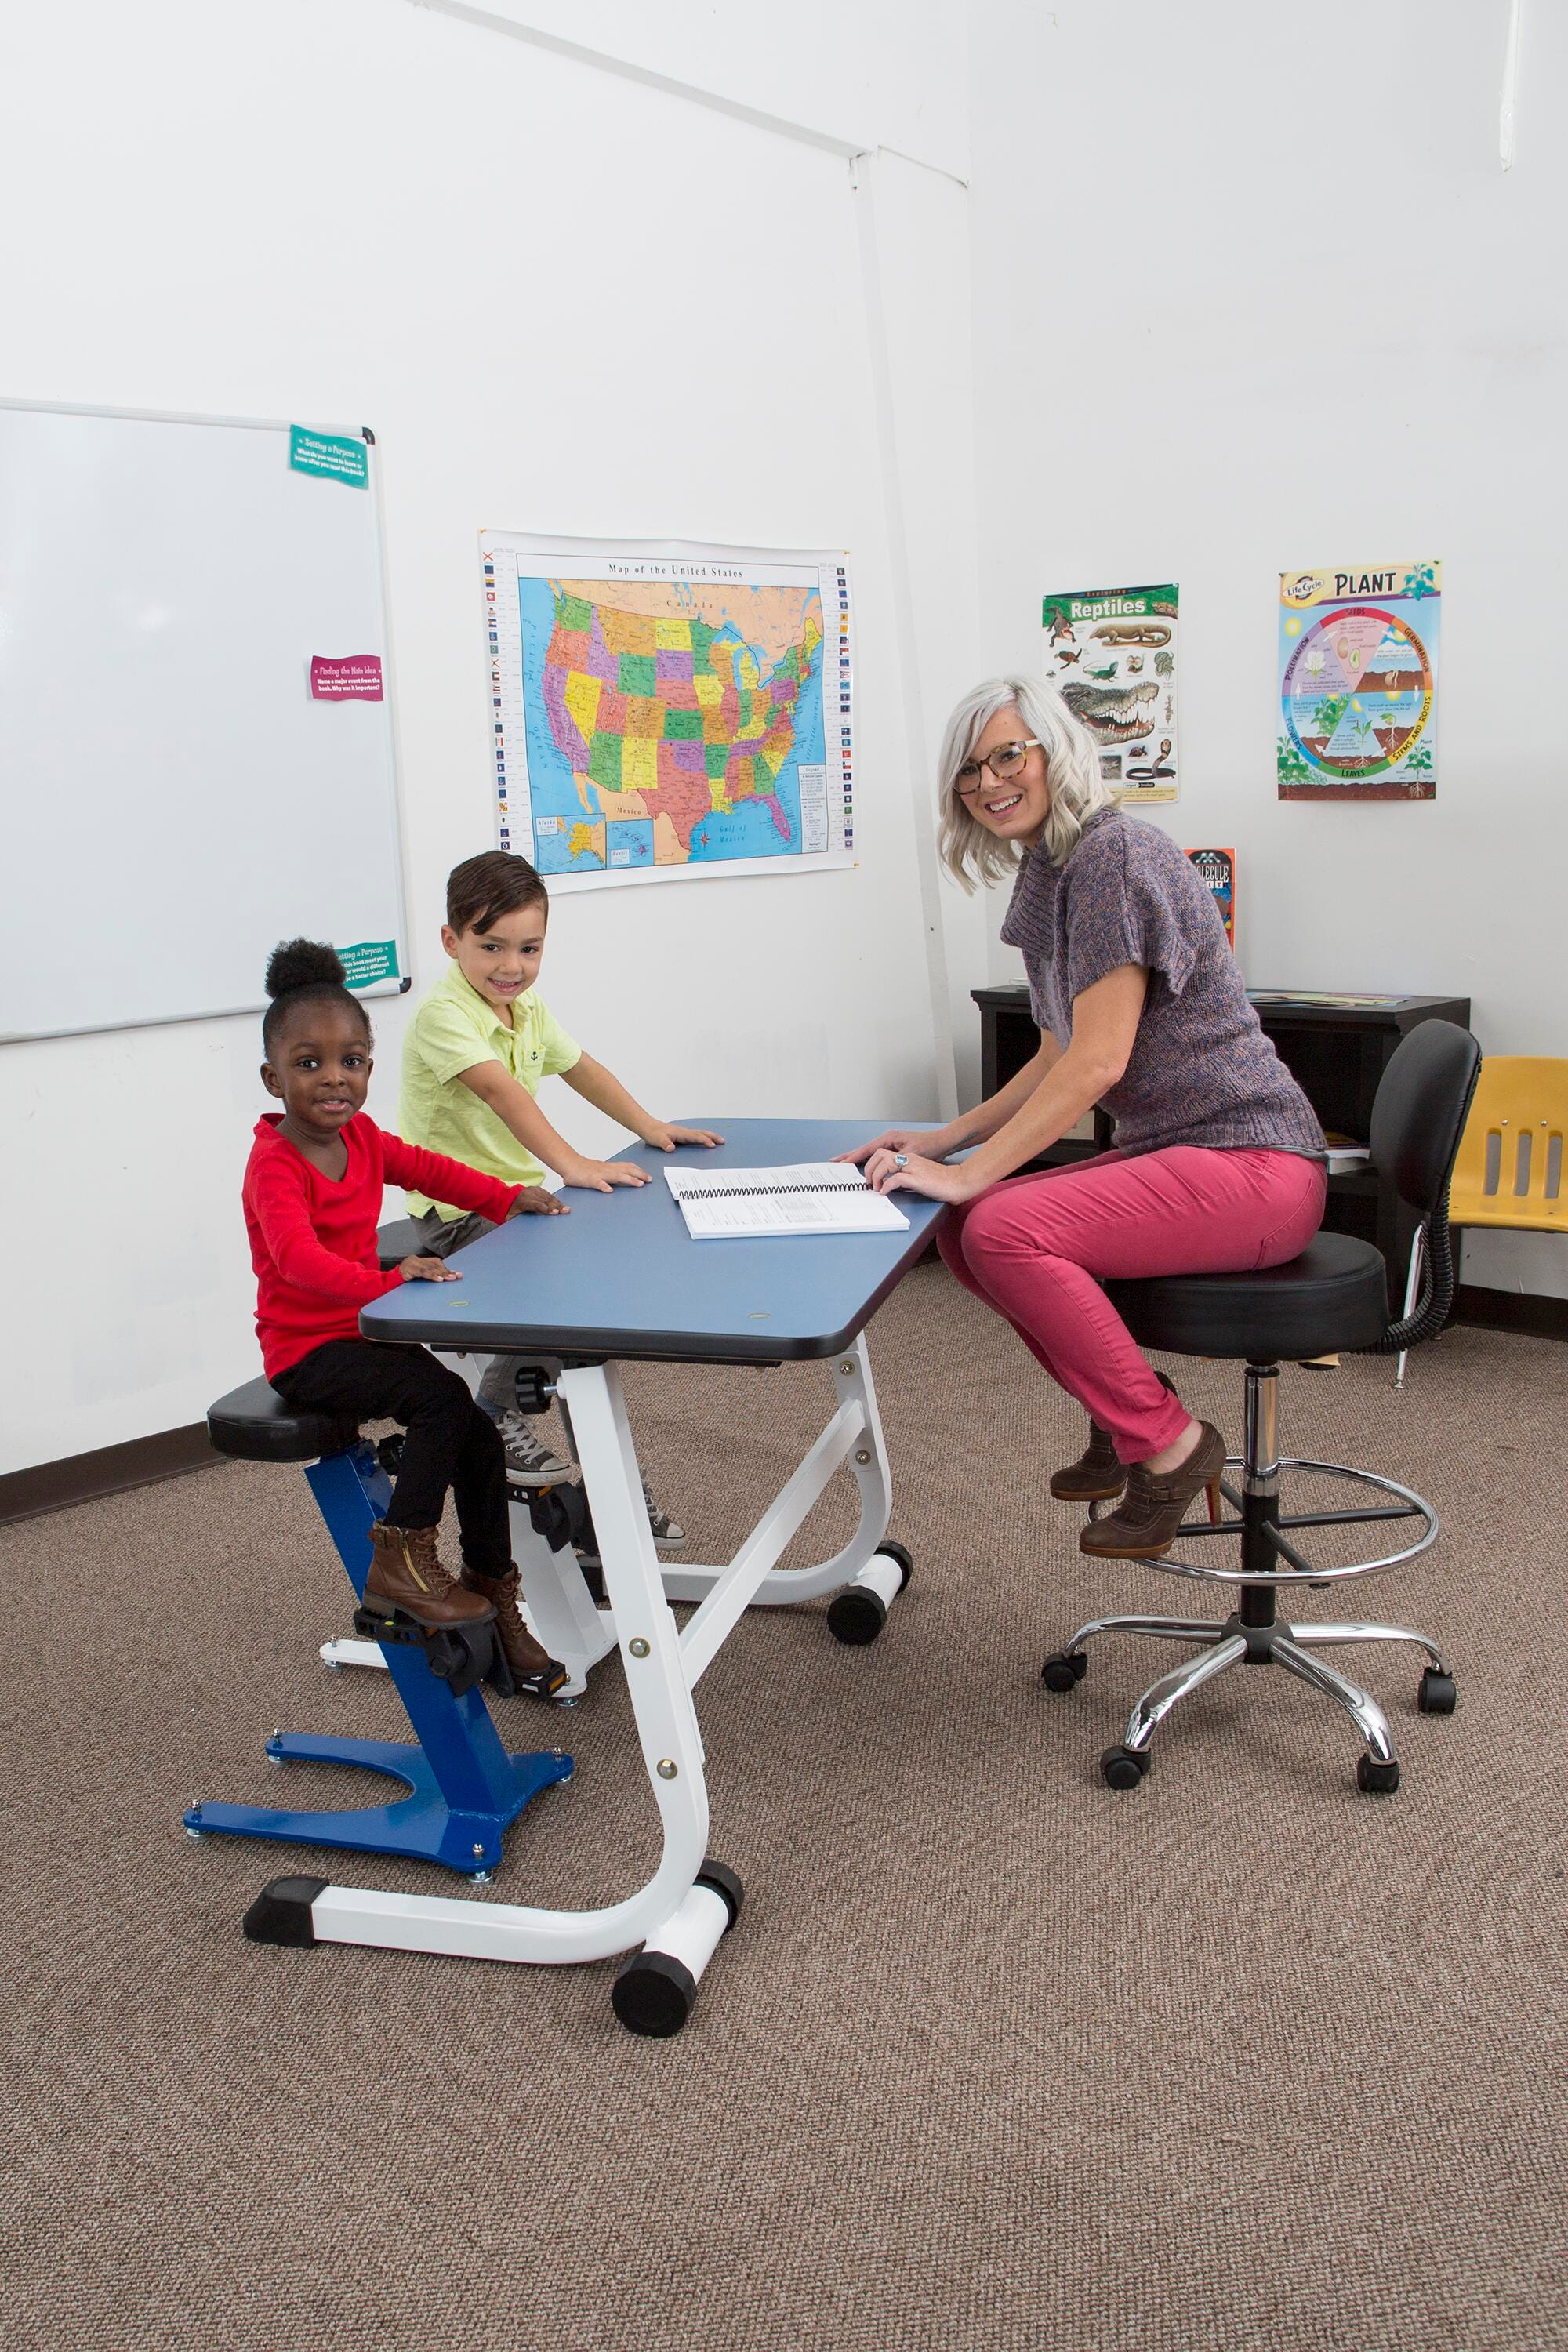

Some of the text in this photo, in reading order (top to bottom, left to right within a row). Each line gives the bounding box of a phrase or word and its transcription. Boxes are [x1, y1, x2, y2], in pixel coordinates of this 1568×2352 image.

[305, 437, 327, 452] Setting
[332, 445, 355, 458] Purpose
[295, 454, 308, 463] know
[350, 468, 365, 477] book?
[609, 564, 630, 575] Map
[650, 566, 666, 575] the
[672, 565, 706, 576] United
[712, 567, 743, 578] States
[1287, 581, 1322, 596] Life Cycle
[1335, 572, 1396, 596] PLANT
[666, 600, 713, 608] Canada
[1071, 598, 1145, 620] Reptiles
[1284, 637, 1309, 681] POLLINATION
[1404, 628, 1430, 673] GERMINATION
[320, 666, 376, 677] Finding the Main Idea
[1285, 717, 1302, 750] FLOWERS
[1392, 741, 1413, 761] STEMS
[1412, 725, 1423, 740] AND
[1419, 696, 1431, 721] ROOTS
[617, 807, 641, 815] Mexico
[1196, 866, 1229, 883] OLECULE
[338, 951, 356, 960] etting
[361, 947, 383, 956] Purpose
